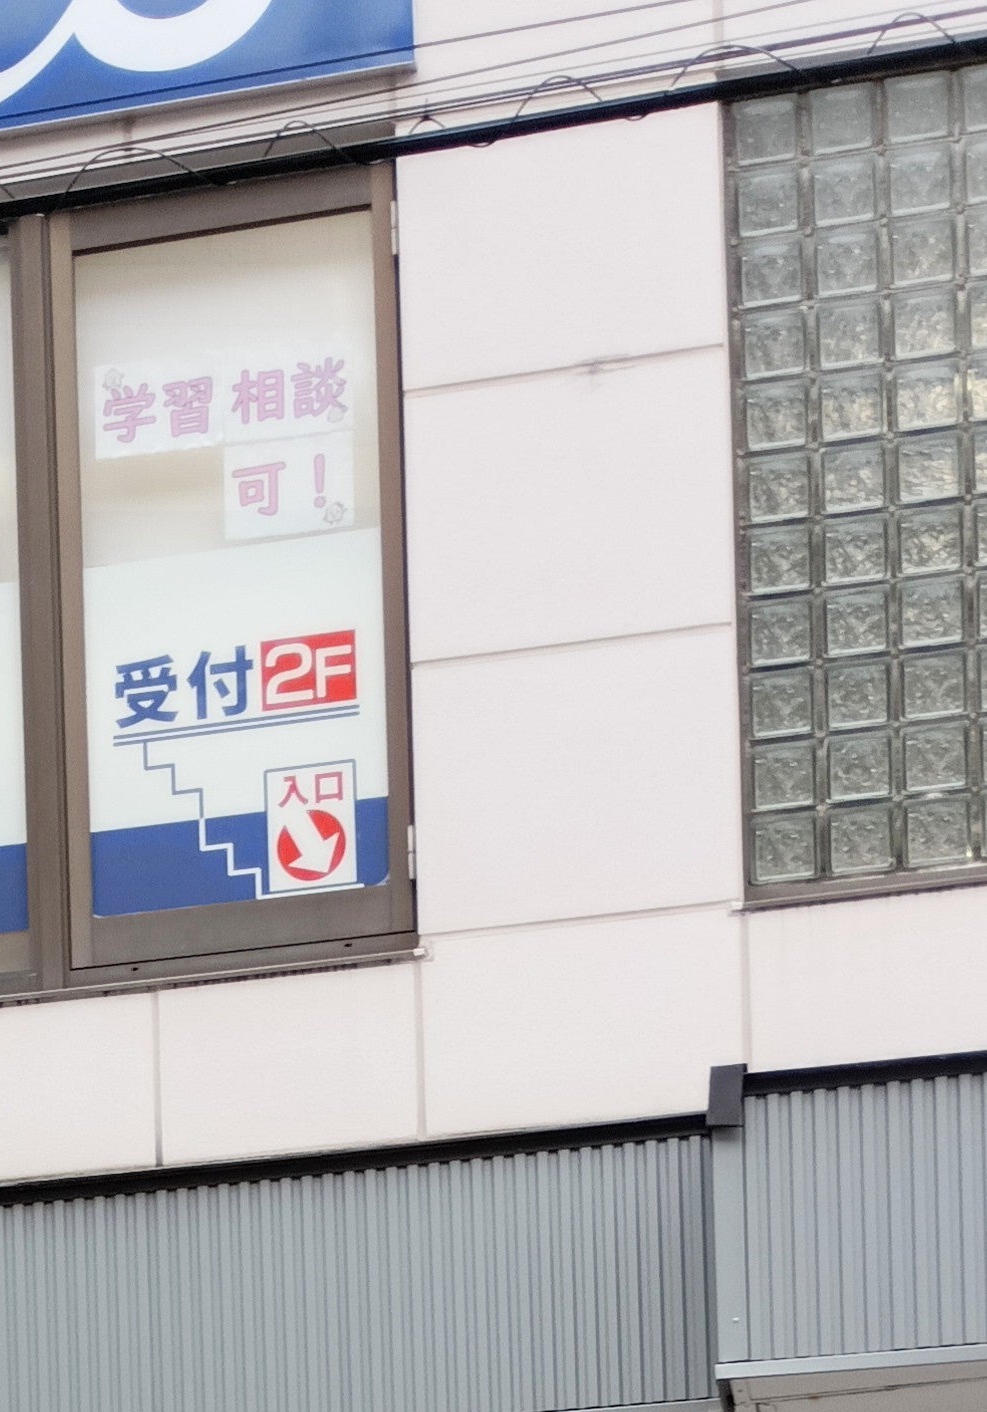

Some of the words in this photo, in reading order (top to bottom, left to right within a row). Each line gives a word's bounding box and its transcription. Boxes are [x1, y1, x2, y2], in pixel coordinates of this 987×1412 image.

[114, 645, 254, 729] 受付
[264, 642, 353, 704] 2F
[277, 770, 344, 808] 入口
